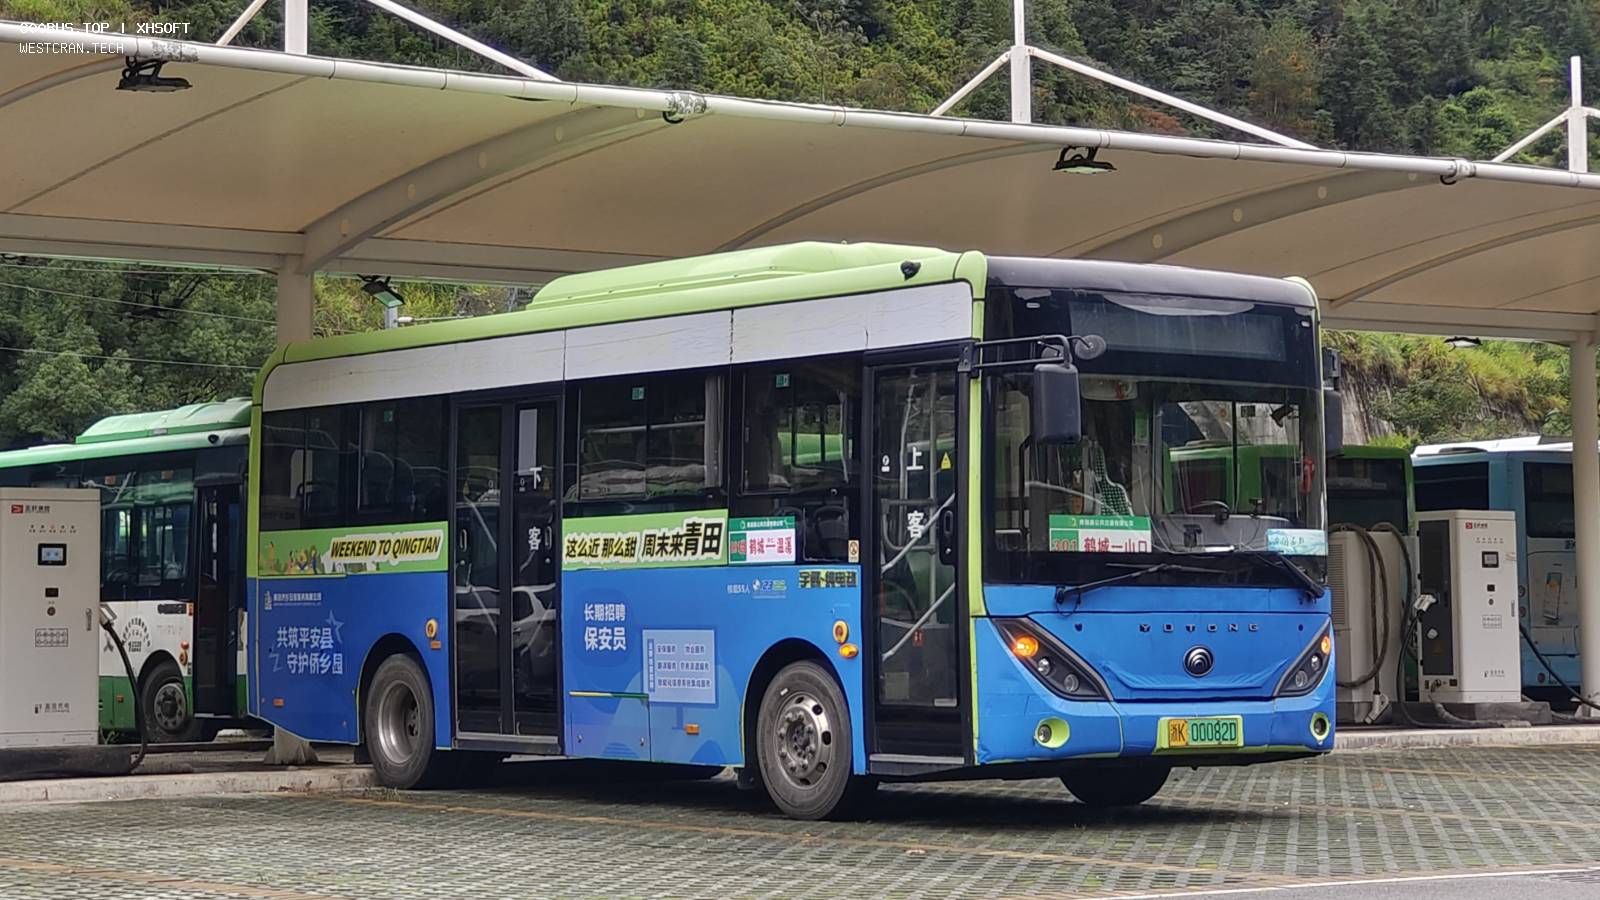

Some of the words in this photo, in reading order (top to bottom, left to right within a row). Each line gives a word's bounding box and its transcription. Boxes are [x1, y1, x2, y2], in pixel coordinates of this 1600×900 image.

[330, 539, 377, 559] WEEKEND
[378, 538, 392, 556] TO
[392, 535, 441, 559] QINGTIAN
[565, 535, 600, 559] 这么近
[601, 533, 637, 559] 那么甜
[583, 603, 626, 622] 长期招聘
[276, 626, 334, 650] 共筑平安县
[583, 626, 627, 651] 保安员
[286, 652, 344, 675] 守护侨乡园
[1191, 722, 1237, 742] 00082D
